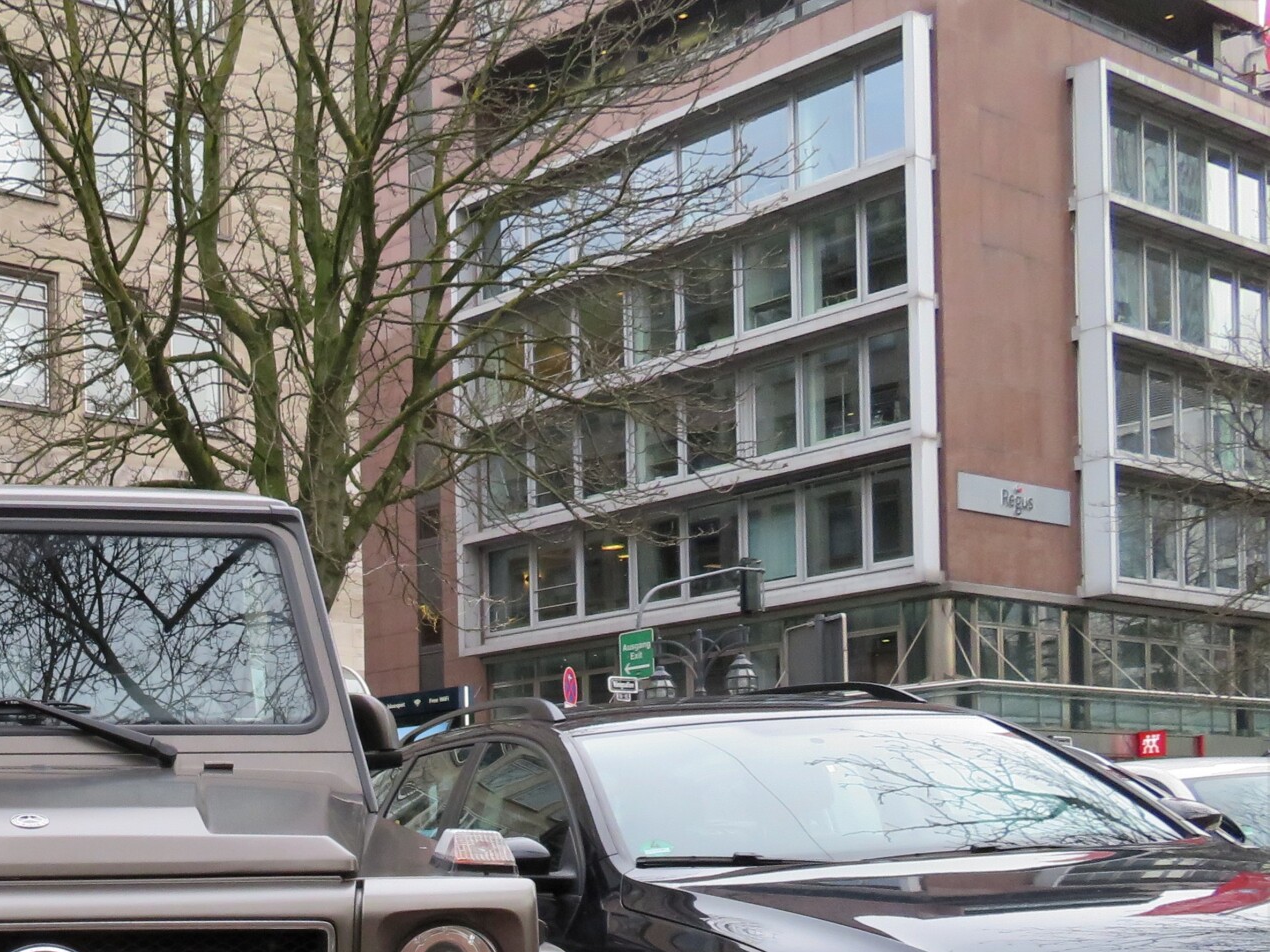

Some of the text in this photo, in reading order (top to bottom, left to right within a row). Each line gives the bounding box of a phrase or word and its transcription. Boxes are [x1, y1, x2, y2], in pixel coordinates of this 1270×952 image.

[1001, 488, 1034, 516] Regus
[622, 641, 651, 652] Ausgang
[630, 651, 643, 660] Exit
